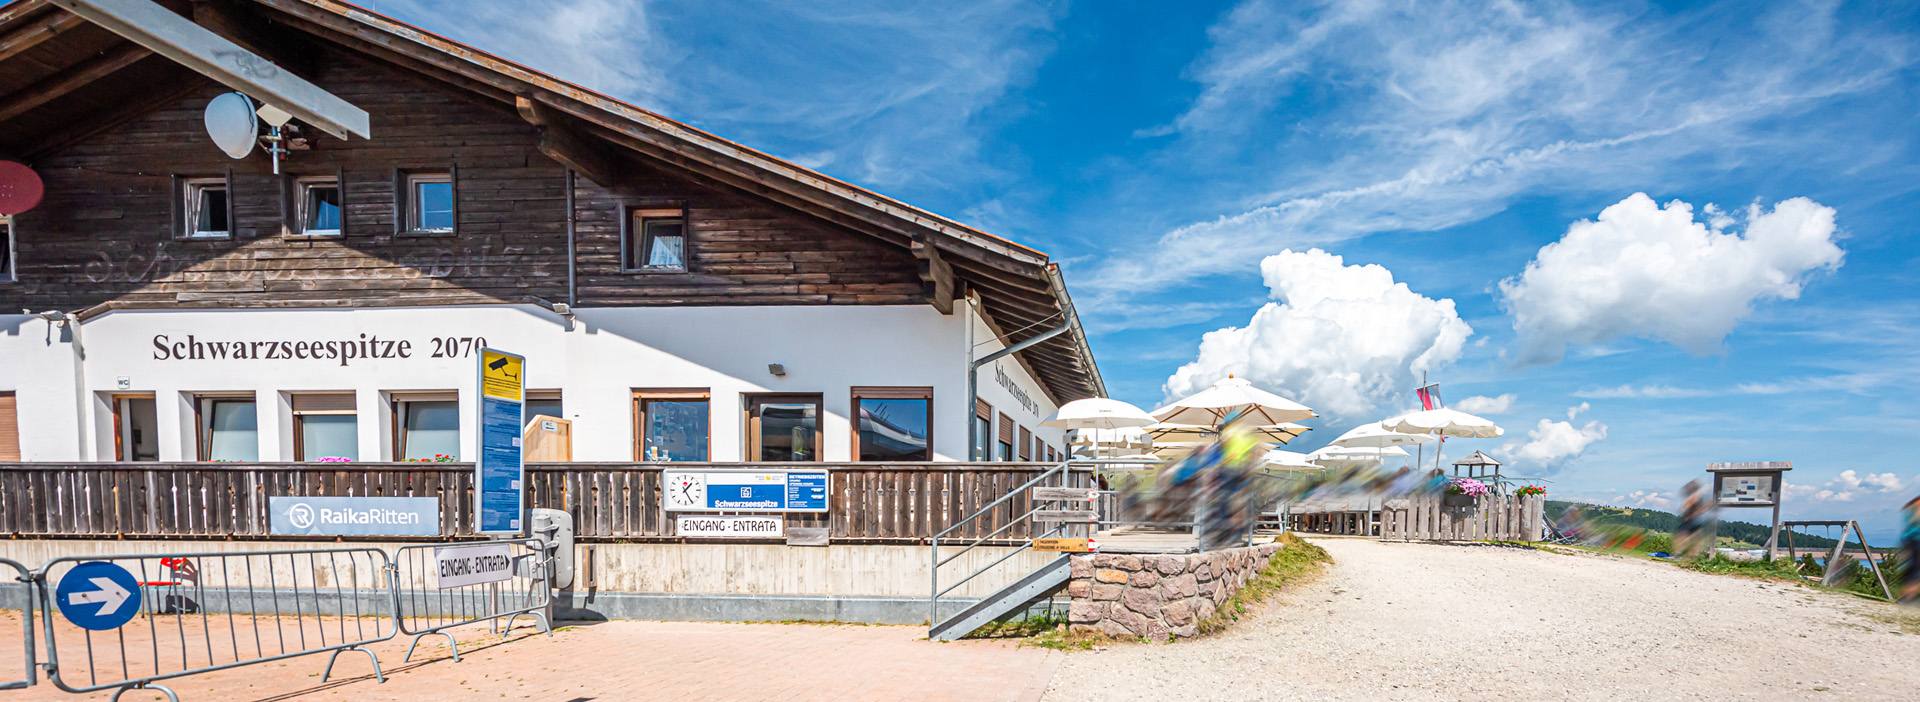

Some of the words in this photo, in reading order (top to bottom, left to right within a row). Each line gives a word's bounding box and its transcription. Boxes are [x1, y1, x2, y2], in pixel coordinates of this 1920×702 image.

[153, 334, 412, 367] Schwarzseespitze
[430, 336, 488, 359] 2070
[714, 499, 779, 509] Schwarzseespitze
[320, 507, 420, 526] RaikaRitten
[683, 519, 726, 532] EINGANG
[733, 520, 777, 532] ENTRATA
[440, 557, 472, 578] EINGANG
[475, 554, 506, 575] ENTRATA
